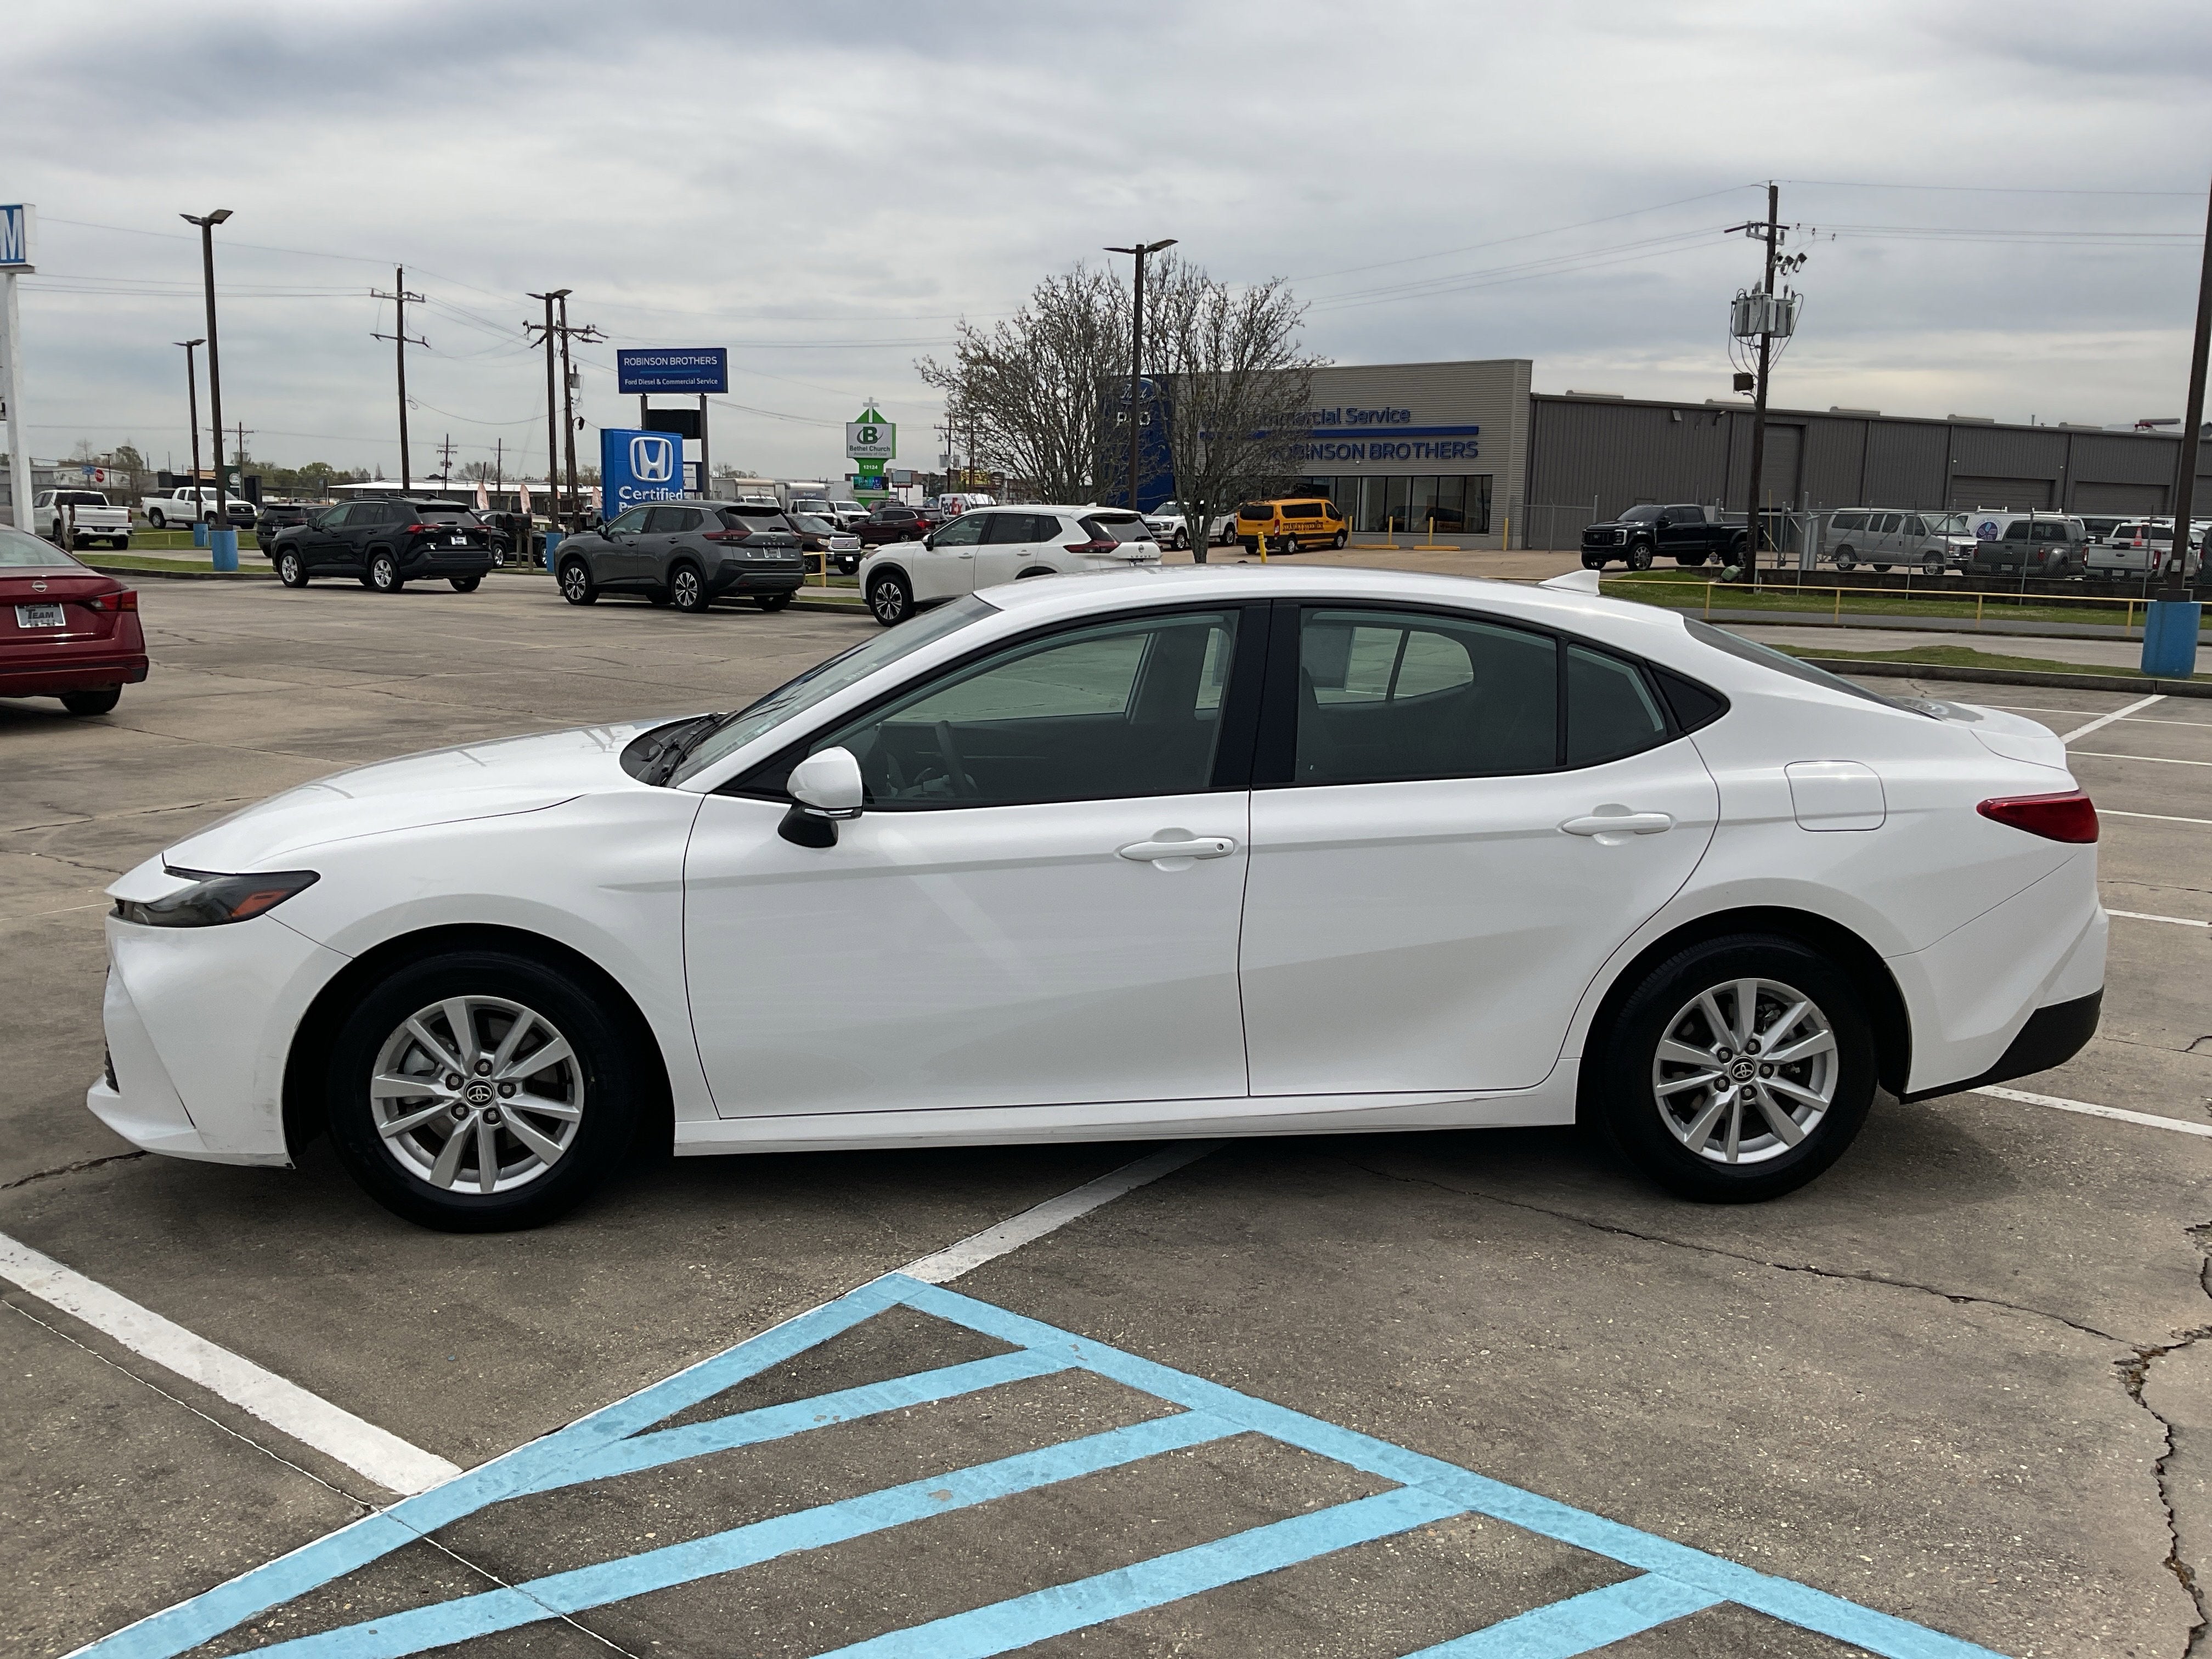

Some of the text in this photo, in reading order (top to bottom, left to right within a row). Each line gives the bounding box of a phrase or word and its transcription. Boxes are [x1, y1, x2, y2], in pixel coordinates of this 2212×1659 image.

[0, 208, 25, 260] M
[624, 357, 718, 366] ROBINSON BROTHERS
[1117, 411, 1150, 426] PO
[1346, 407, 1410, 425] Service
[863, 426, 878, 442] B
[1369, 441, 1479, 460] BROTHERS
[619, 486, 683, 501] Certified
[941, 497, 963, 515] FedEx
[25, 608, 54, 619] TEAM
